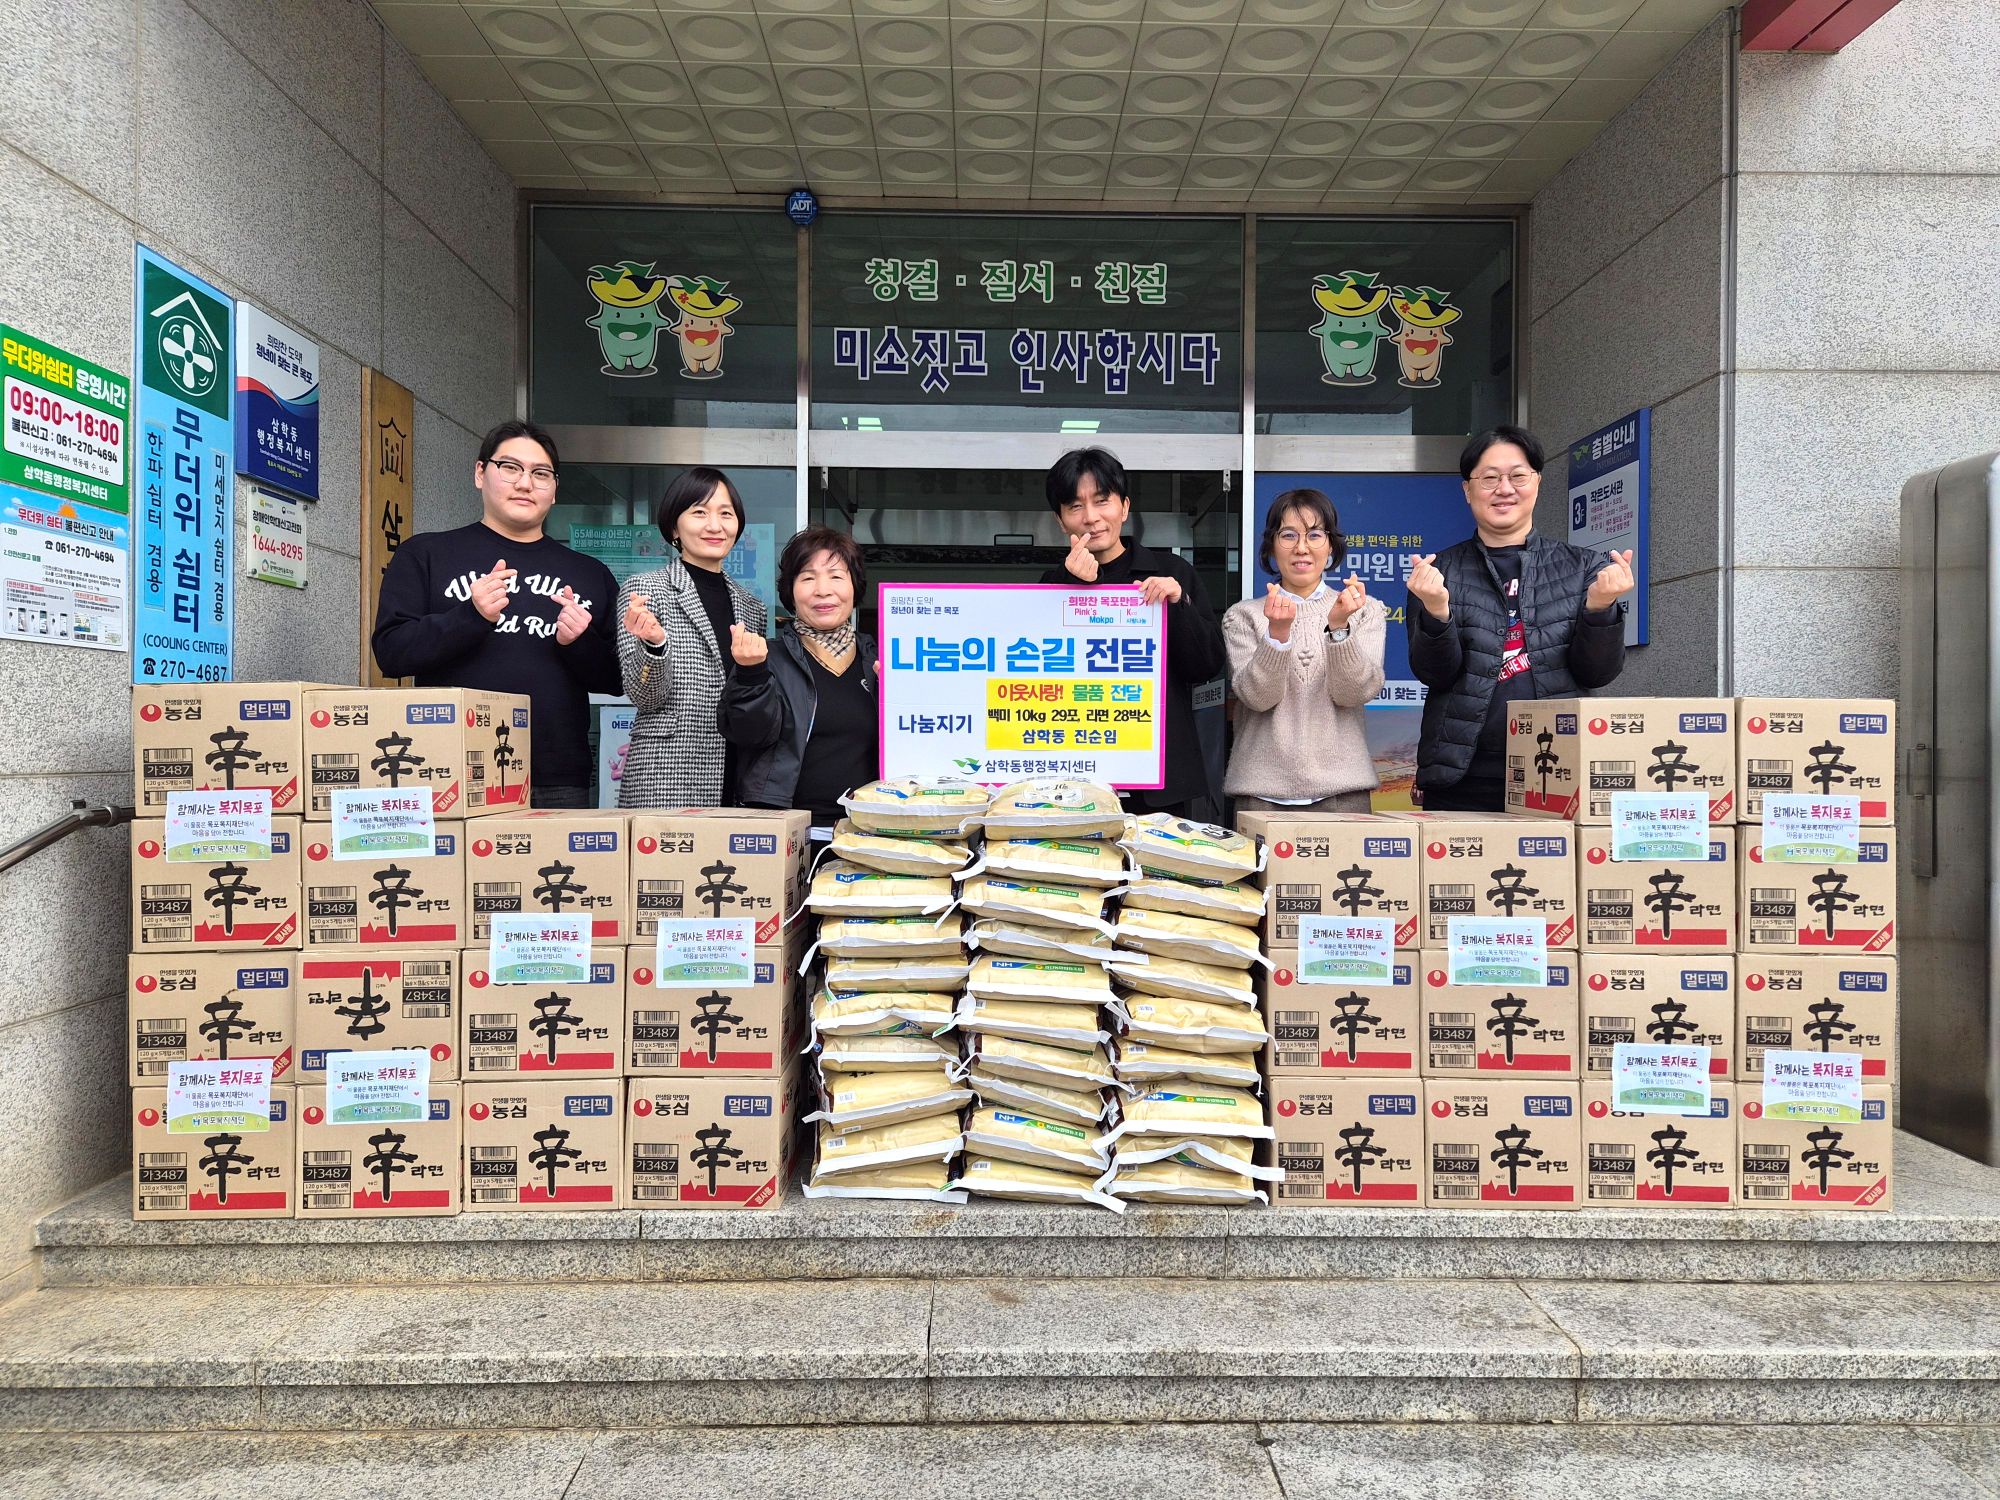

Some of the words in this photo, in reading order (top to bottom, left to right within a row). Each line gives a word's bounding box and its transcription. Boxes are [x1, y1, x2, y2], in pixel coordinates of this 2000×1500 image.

[791, 200, 812, 212] ADT
[865, 258, 938, 301] 청결
[980, 259, 1054, 303] 질서
[1095, 260, 1168, 304] 친절
[267, 334, 287, 355] 희망찬
[256, 343, 276, 365] 청년이
[278, 352, 291, 373] 찾는
[292, 362, 299, 377] 큰
[300, 366, 313, 385] 목포
[834, 326, 988, 394] 미소짓고
[1010, 328, 1220, 395] 인사합시다
[3, 337, 73, 388] 무더위쉼터
[76, 367, 126, 410] 운영시간
[10, 386, 119, 446] 09:00~18:00
[271, 417, 297, 440] 삼학동
[12, 417, 49, 441] 불편신고
[56, 433, 117, 463] 061-270-4694
[256, 428, 312, 464] 행정복지센터
[1591, 420, 1635, 461] 층별안내
[147, 431, 163, 480] 한파
[173, 407, 203, 537] 무더위
[24, 464, 108, 500] 삼학동행정복지센터
[214, 454, 226, 535] 미세먼지
[1590, 479, 1623, 504] 작은도서관
[147, 483, 162, 530] 쉼터
[18, 508, 44, 525] 무더위
[47, 516, 63, 530] 쉼터
[65, 519, 97, 538] 불편신고
[99, 528, 114, 541] 안내
[253, 510, 302, 534] 장애인학대신고전화
[608, 529, 632, 539] 어르신
[1368, 535, 1399, 548] 편익을
[1401, 535, 1423, 548] 위한
[56, 541, 114, 563] 061-270-4694
[252, 534, 303, 561] 1644-8295
[214, 536, 225, 578] 쉼터
[147, 543, 163, 593] 겸용
[173, 548, 201, 633] 쉼터
[214, 582, 225, 622] 겸용
[890, 596, 915, 606] 희망찬
[1068, 596, 1098, 607] 희망찬
[890, 606, 914, 615] 청년이
[916, 606, 932, 615] 찾는
[934, 606, 942, 615] 큰
[944, 606, 960, 615] 목포
[1089, 616, 1114, 624] Mokpo
[143, 634, 190, 651] (COOLING
[192, 639, 228, 656] CENTER)
[890, 636, 996, 672] 나눔의
[1005, 637, 1076, 672] 손길
[1085, 637, 1157, 673] 전달
[160, 658, 227, 682] 270-4687
[997, 683, 1064, 702] 이웃사랑!
[1072, 684, 1105, 702] 물품
[1110, 684, 1143, 702] 전달
[1395, 687, 1417, 700] 찾는
[165, 706, 201, 721] 농심
[245, 703, 285, 717] 멀티팩
[334, 709, 368, 726] 농심
[411, 707, 450, 721] 멀티팩
[988, 709, 1011, 723] 백미
[1016, 709, 1046, 723] 10kg
[1086, 709, 1110, 723] 라면
[1113, 709, 1152, 723] 28박스
[898, 714, 972, 734] 나눔지기
[1610, 718, 1644, 734] 농심
[1684, 716, 1722, 730] 멀티팩
[1769, 718, 1803, 733] 농심
[1844, 716, 1885, 731] 멀티팩
[1022, 729, 1065, 744] 삼학동
[1074, 729, 1117, 744] 진순임
[147, 766, 190, 776] 가3487
[985, 759, 1097, 774] 삼학동행정복지센터
[177, 803, 215, 816] 함께사는
[219, 799, 263, 814] 복지목포
[1625, 808, 1658, 821] 함께사는
[1660, 806, 1697, 820] 복지목포
[1773, 805, 1808, 819] 함께사는
[1810, 804, 1853, 819] 복지목포
[496, 839, 531, 855] 농심
[573, 835, 612, 849] 멀티팩
[660, 839, 693, 853] 농심
[1369, 841, 1406, 854] 멀티팩
[1523, 840, 1562, 853] 멀티팩
[1296, 844, 1329, 857] 농심
[1449, 844, 1482, 857] 농심
[145, 902, 188, 913] 가3487
[254, 897, 287, 911] 라면
[477, 899, 518, 909] 가3487
[1280, 901, 1318, 911] 가3487
[1591, 904, 1630, 916] 가3487
[1690, 904, 1721, 917] 라면
[1754, 904, 1794, 915] 가3487
[505, 930, 538, 942] 함께사는
[540, 929, 580, 942] 복지목포
[160, 976, 196, 991] 농심
[242, 971, 283, 986] 멀티팩
[1611, 977, 1644, 990] 농심
[1685, 973, 1723, 988] 멀티팩
[576, 1028, 608, 1041] 라면
[635, 1028, 677, 1039] 가3487
[1433, 1029, 1473, 1040] 가3487
[1533, 1029, 1565, 1042] 라면
[1774, 1063, 1810, 1076] 함께사는
[1812, 1062, 1854, 1077] 복지목포
[492, 1105, 526, 1119] 농심
[569, 1098, 607, 1113] 멀티팩
[999, 1114, 1015, 1122] NH
[410, 1163, 443, 1178] 라면
[1592, 1160, 1632, 1171] 가3487
[1848, 1162, 1879, 1174] 라면
[306, 1168, 349, 1179] 가3487
